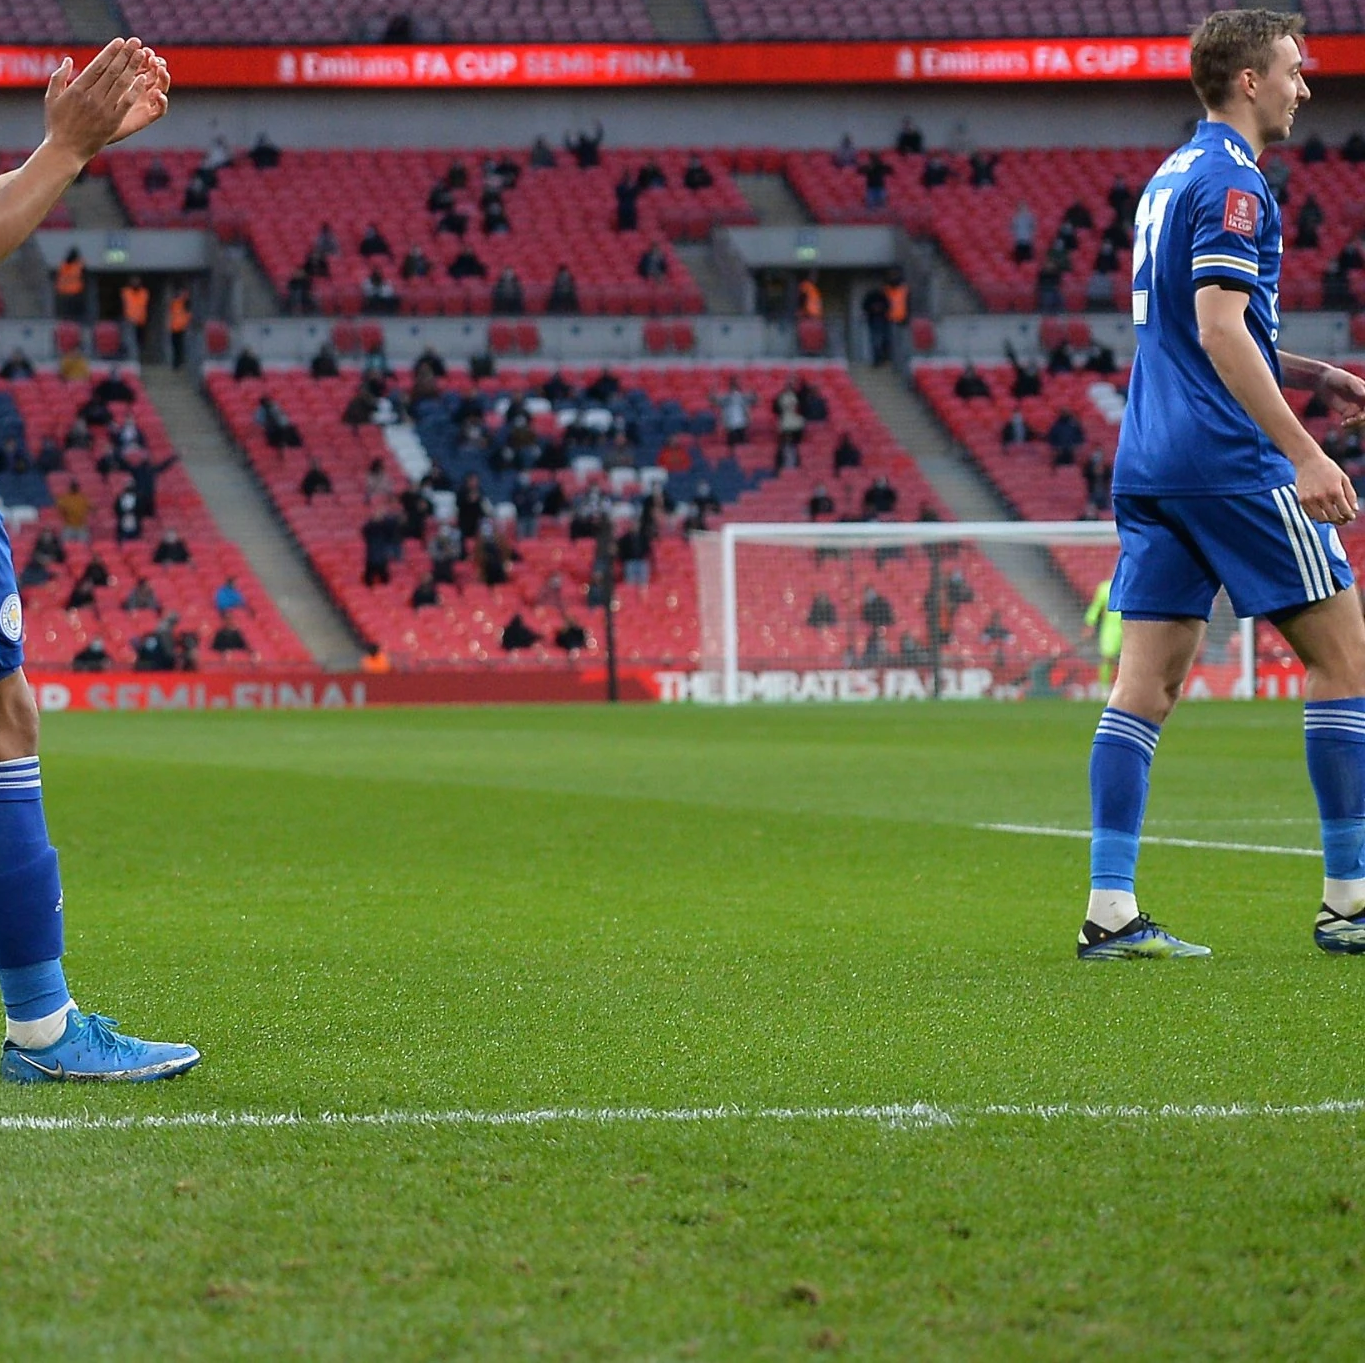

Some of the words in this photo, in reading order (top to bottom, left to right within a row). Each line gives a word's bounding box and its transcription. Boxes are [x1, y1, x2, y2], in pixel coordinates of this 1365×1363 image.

[301, 51, 409, 80] Emirates
[413, 51, 453, 78] FA
[456, 51, 517, 79] CUP
[525, 52, 694, 79] SEMI-FINAL
[920, 46, 1029, 75] Emirates
[1034, 46, 1071, 72] FA
[1074, 45, 1138, 71] CUP
[654, 671, 719, 703] THE
[726, 670, 879, 704] MIRATES
